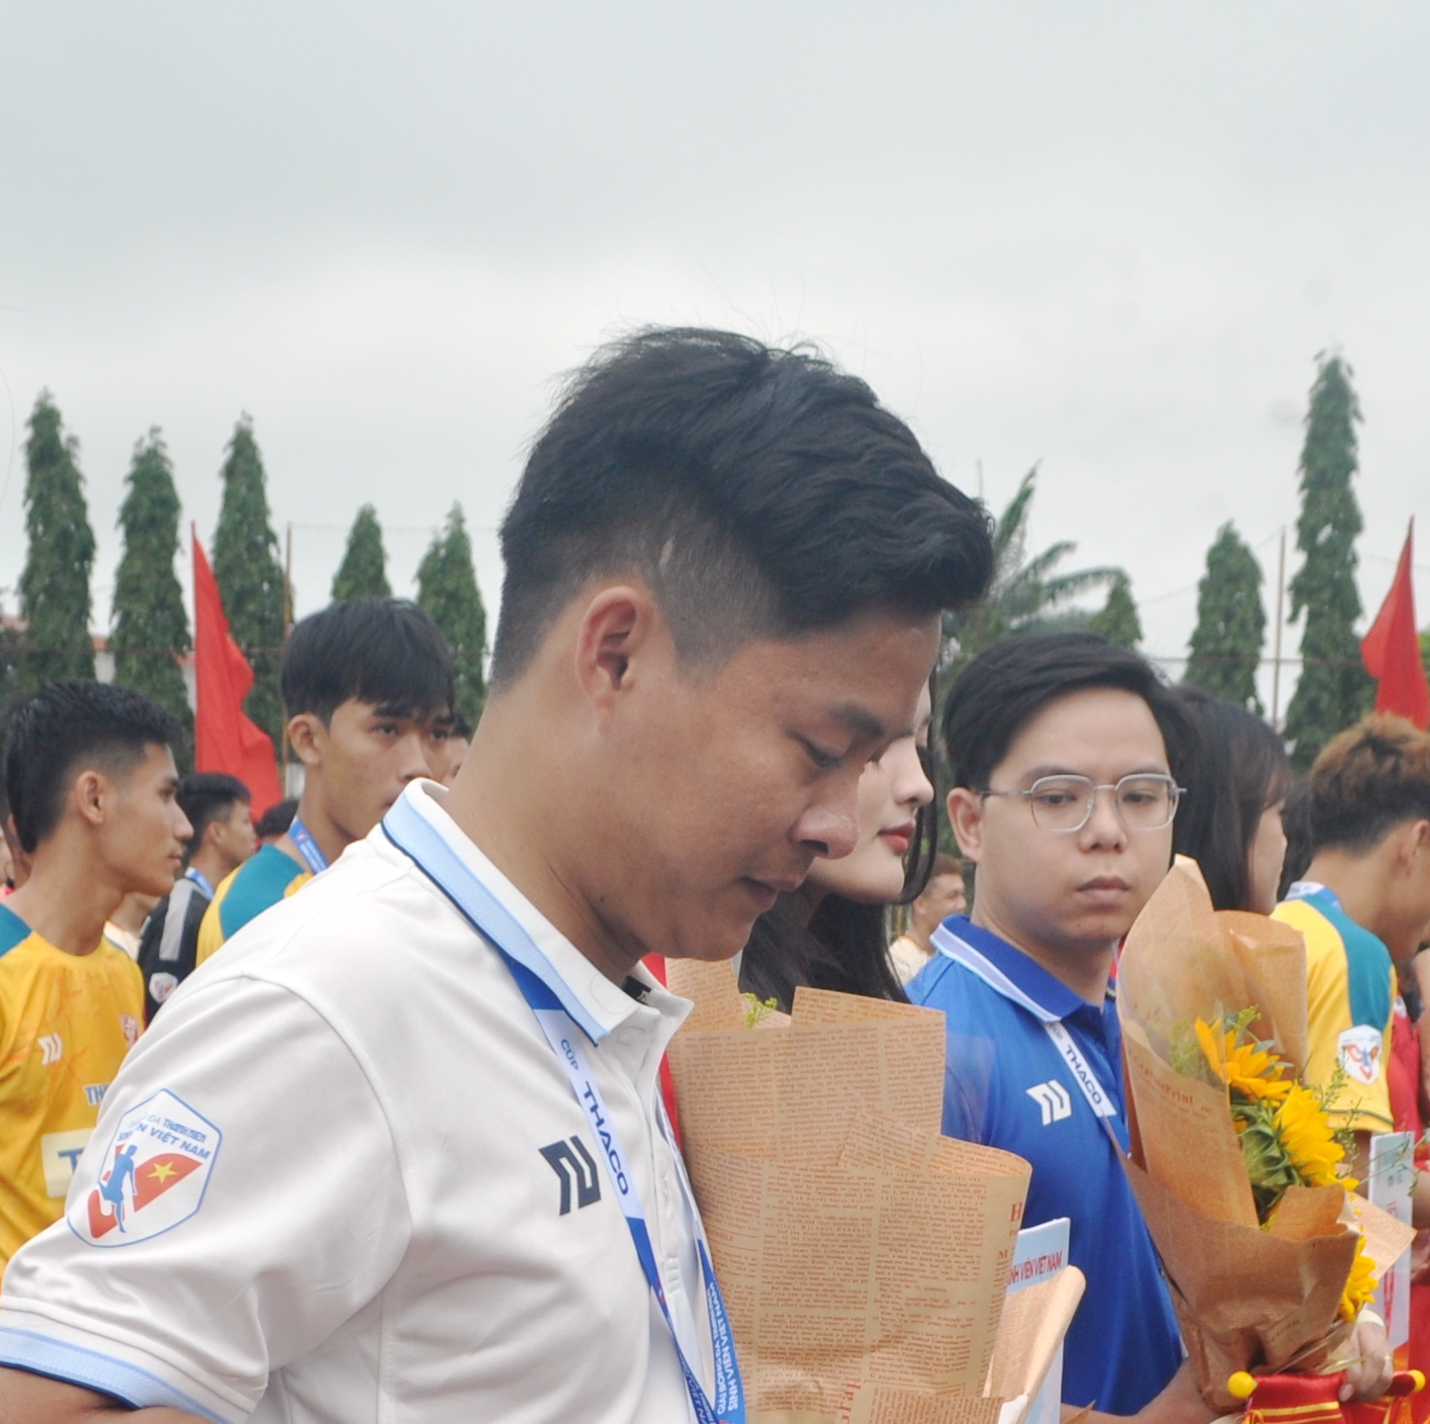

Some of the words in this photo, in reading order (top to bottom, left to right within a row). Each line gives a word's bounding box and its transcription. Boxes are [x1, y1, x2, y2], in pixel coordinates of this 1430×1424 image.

[560, 1038, 579, 1071] CÚP
[1066, 1044, 1102, 1105] THACO
[179, 1141, 211, 1160] NAM
[583, 1081, 629, 1196] THACO
[727, 1380, 739, 1412] SINH
